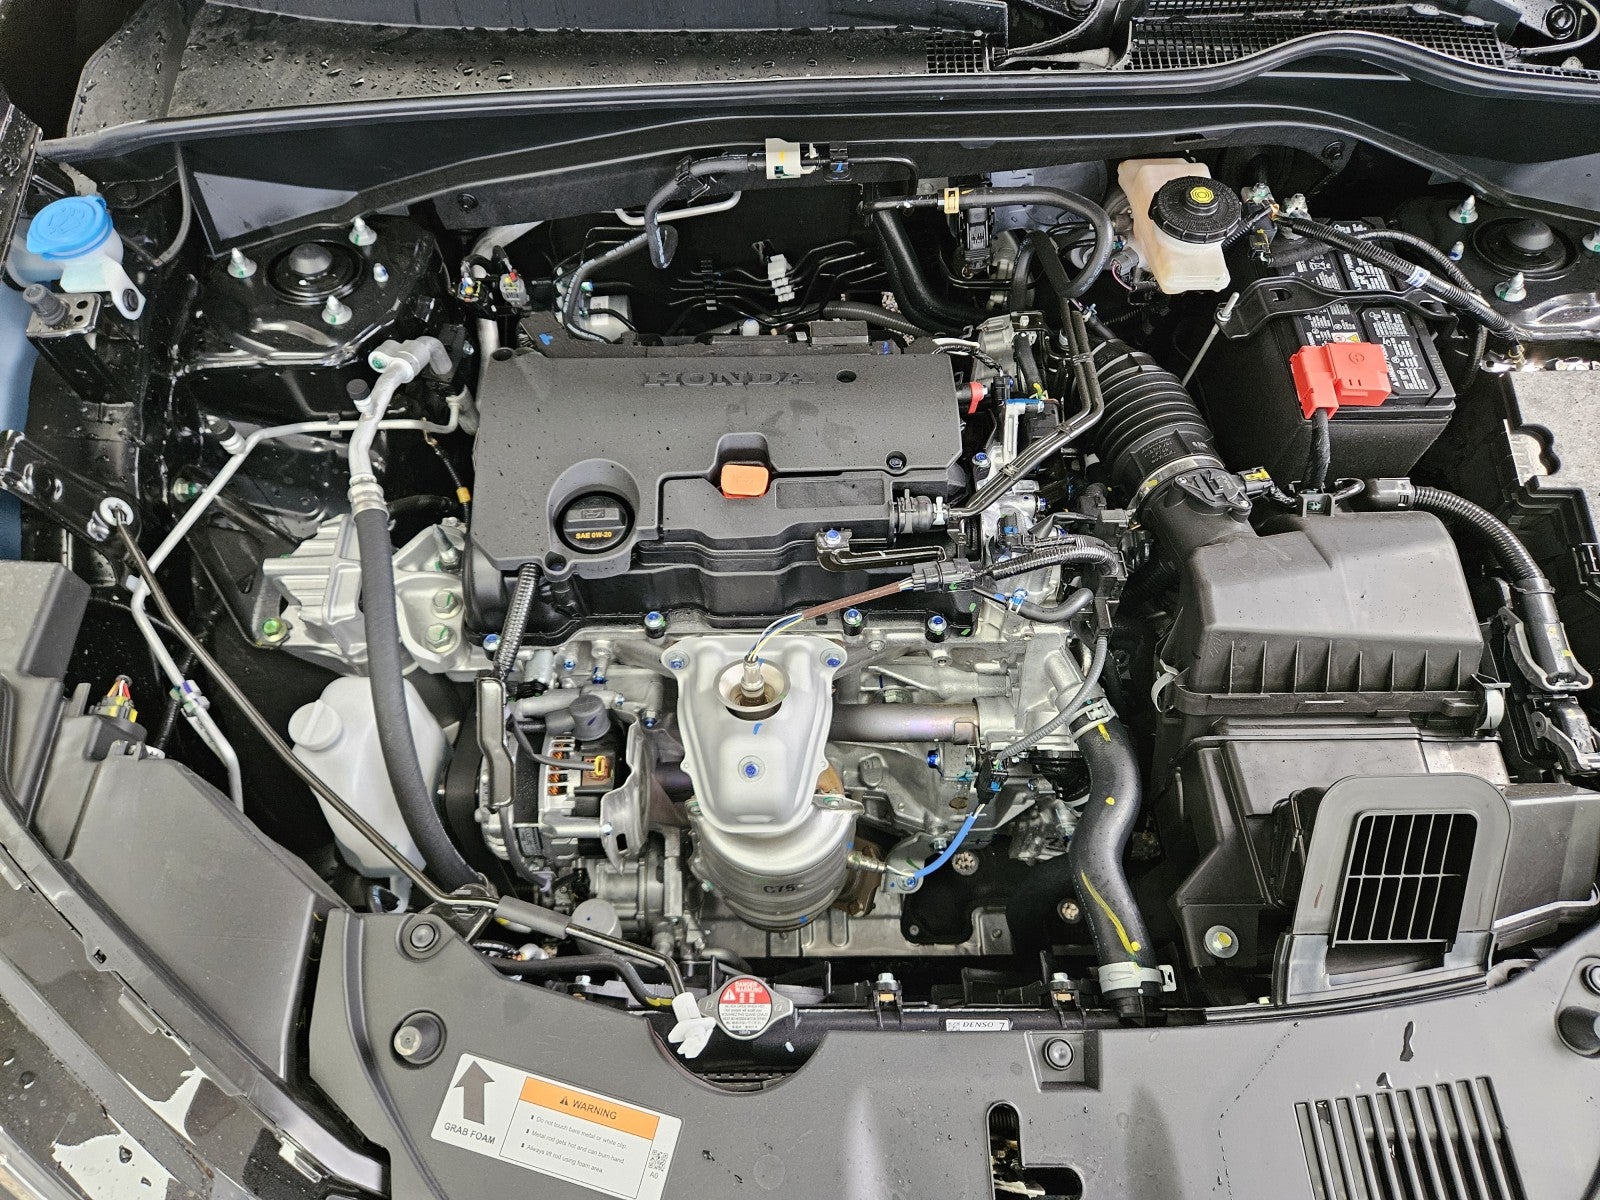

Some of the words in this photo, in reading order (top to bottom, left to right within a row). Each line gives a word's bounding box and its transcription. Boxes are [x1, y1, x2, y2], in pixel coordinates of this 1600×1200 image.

[643, 372, 816, 387] HONDA
[575, 532, 591, 540] SAE
[591, 531, 613, 539] 0W-20
[572, 1099, 617, 1121] WARNING
[443, 1121, 469, 1137] GRAB
[469, 1129, 496, 1145] FOAM
[545, 1118, 554, 1126] not
[554, 1120, 568, 1131] touch
[568, 1124, 581, 1135] bare
[581, 1129, 596, 1139] metal
[602, 1136, 617, 1146] white
[526, 1144, 545, 1156] Always
[545, 1148, 553, 1157] lift
[552, 1151, 562, 1160] rod
[562, 1155, 577, 1166] using
[577, 1158, 591, 1169] foam
[531, 1129, 546, 1139] Metal
[546, 1134, 556, 1142] rod
[555, 1137, 567, 1147] gets
[567, 1140, 577, 1149] hot
[576, 1144, 587, 1152] and
[587, 1148, 598, 1156] can
[598, 1149, 611, 1160] burn
